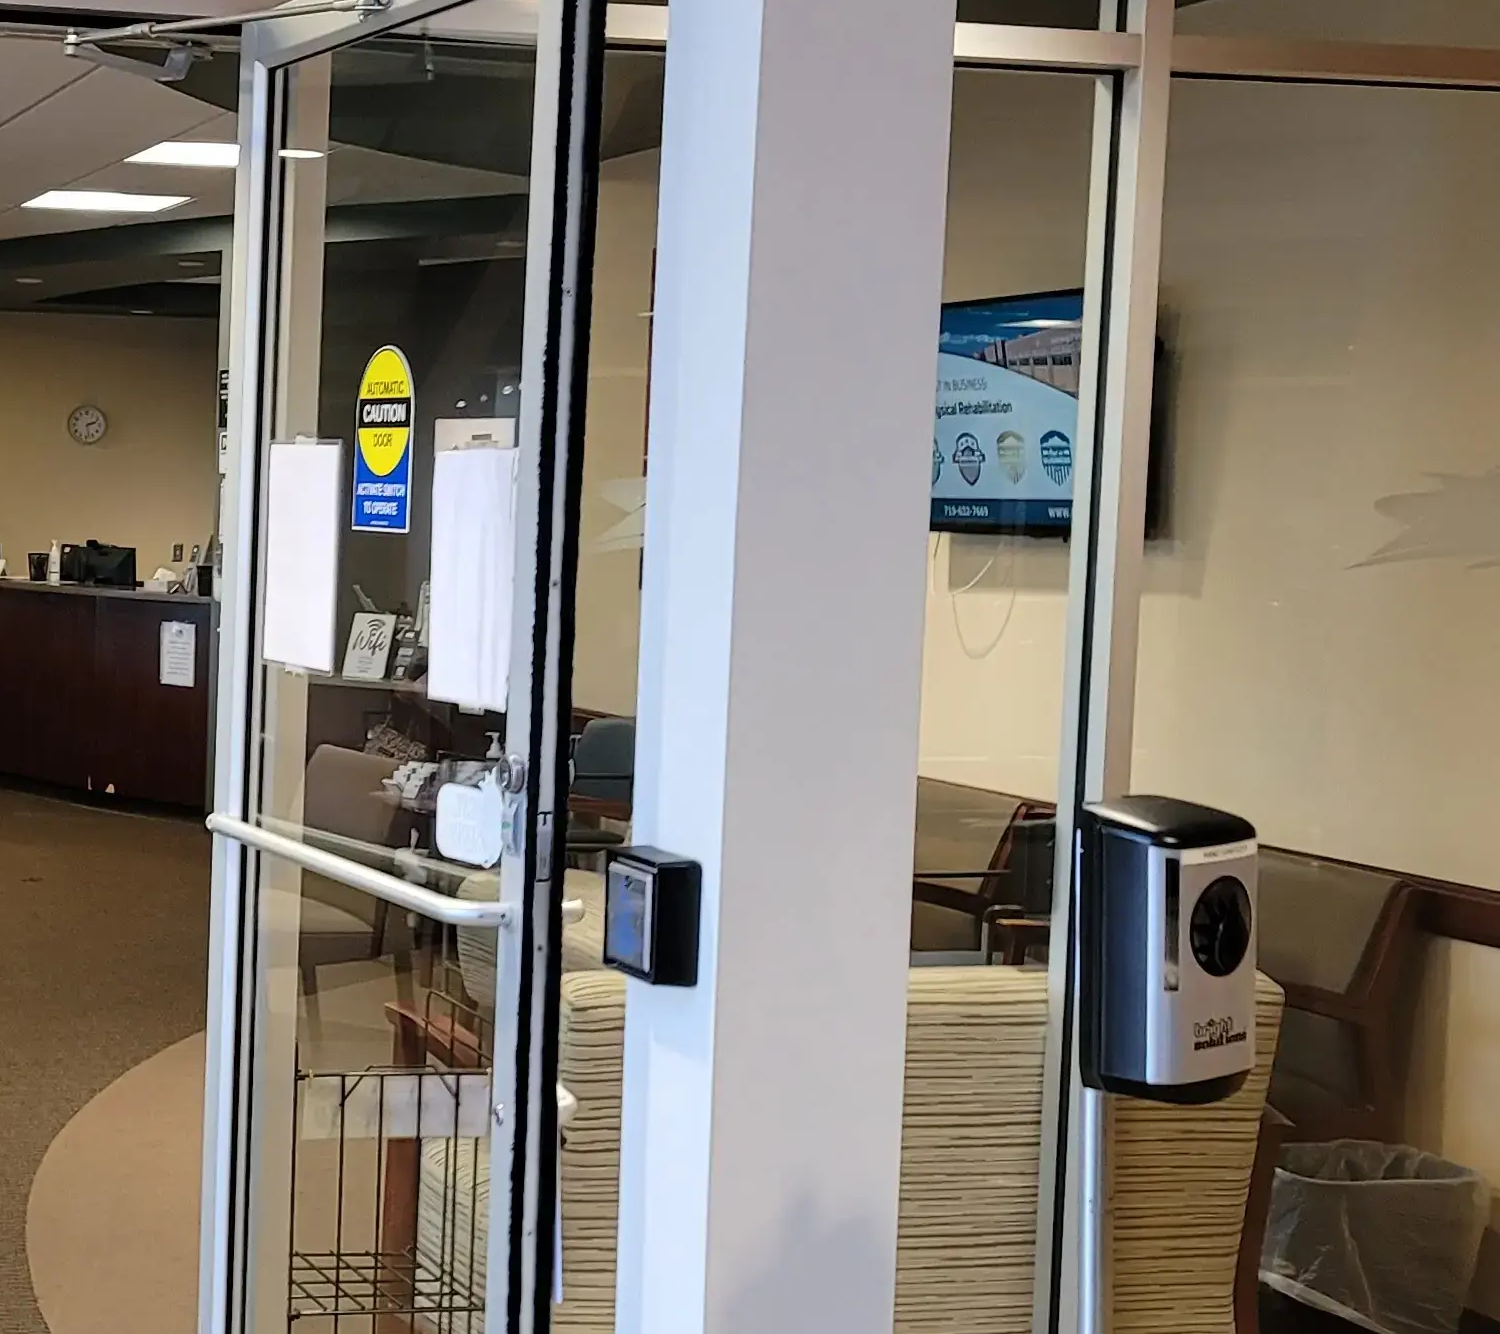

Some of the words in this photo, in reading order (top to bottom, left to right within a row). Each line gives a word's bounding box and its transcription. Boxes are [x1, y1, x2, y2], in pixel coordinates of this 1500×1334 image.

[367, 380, 404, 396] AUTOMATIC
[362, 403, 407, 423] CAUTION
[373, 433, 393, 447] DOOR
[363, 500, 372, 514] TO
[1193, 1016, 1233, 1039] bright
